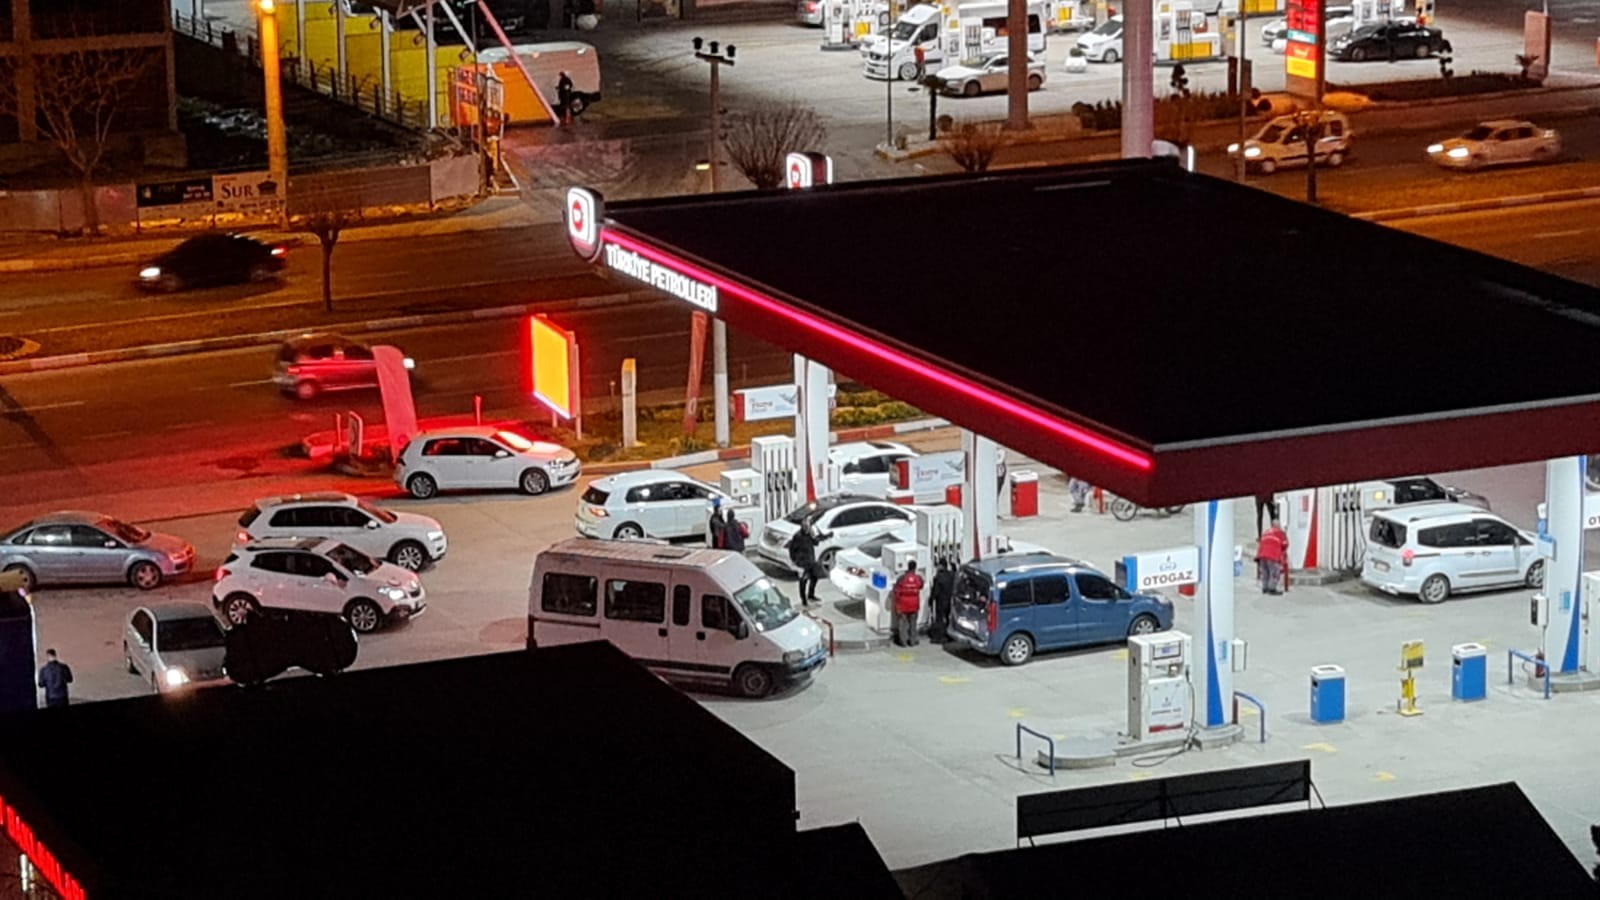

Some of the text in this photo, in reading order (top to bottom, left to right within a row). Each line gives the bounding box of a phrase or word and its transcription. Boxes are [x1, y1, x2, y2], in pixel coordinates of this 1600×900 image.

[221, 182, 253, 199] SUR
[605, 243, 718, 312] TÜRKİYE PETROLLERİ
[1143, 570, 1194, 586] OTOGAZ
